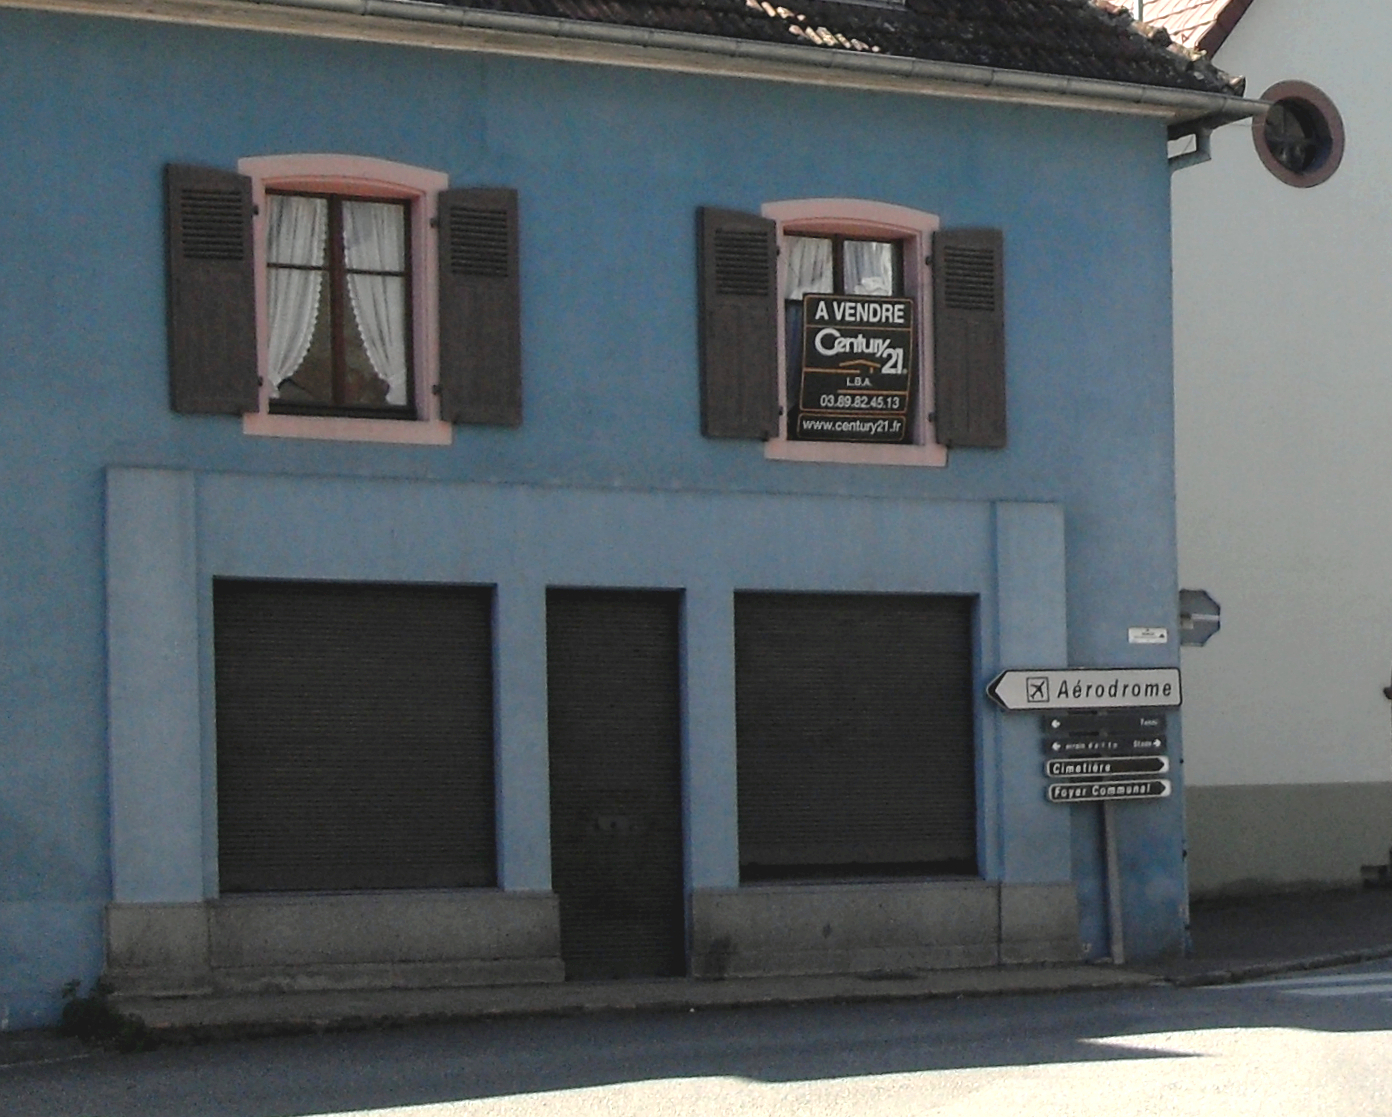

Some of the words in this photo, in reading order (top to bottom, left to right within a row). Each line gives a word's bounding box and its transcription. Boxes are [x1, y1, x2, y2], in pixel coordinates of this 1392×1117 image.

[815, 300, 829, 321] A
[832, 301, 905, 323] VENDRE
[815, 328, 890, 357] Century
[820, 394, 900, 409] 03.89.82.45.13
[802, 419, 901, 435] www.century21.fr
[1057, 679, 1172, 699] Aérodrome
[1053, 762, 1111, 774] Cimetière
[1054, 784, 1087, 798] Foyer
[1091, 783, 1151, 796] Communal
